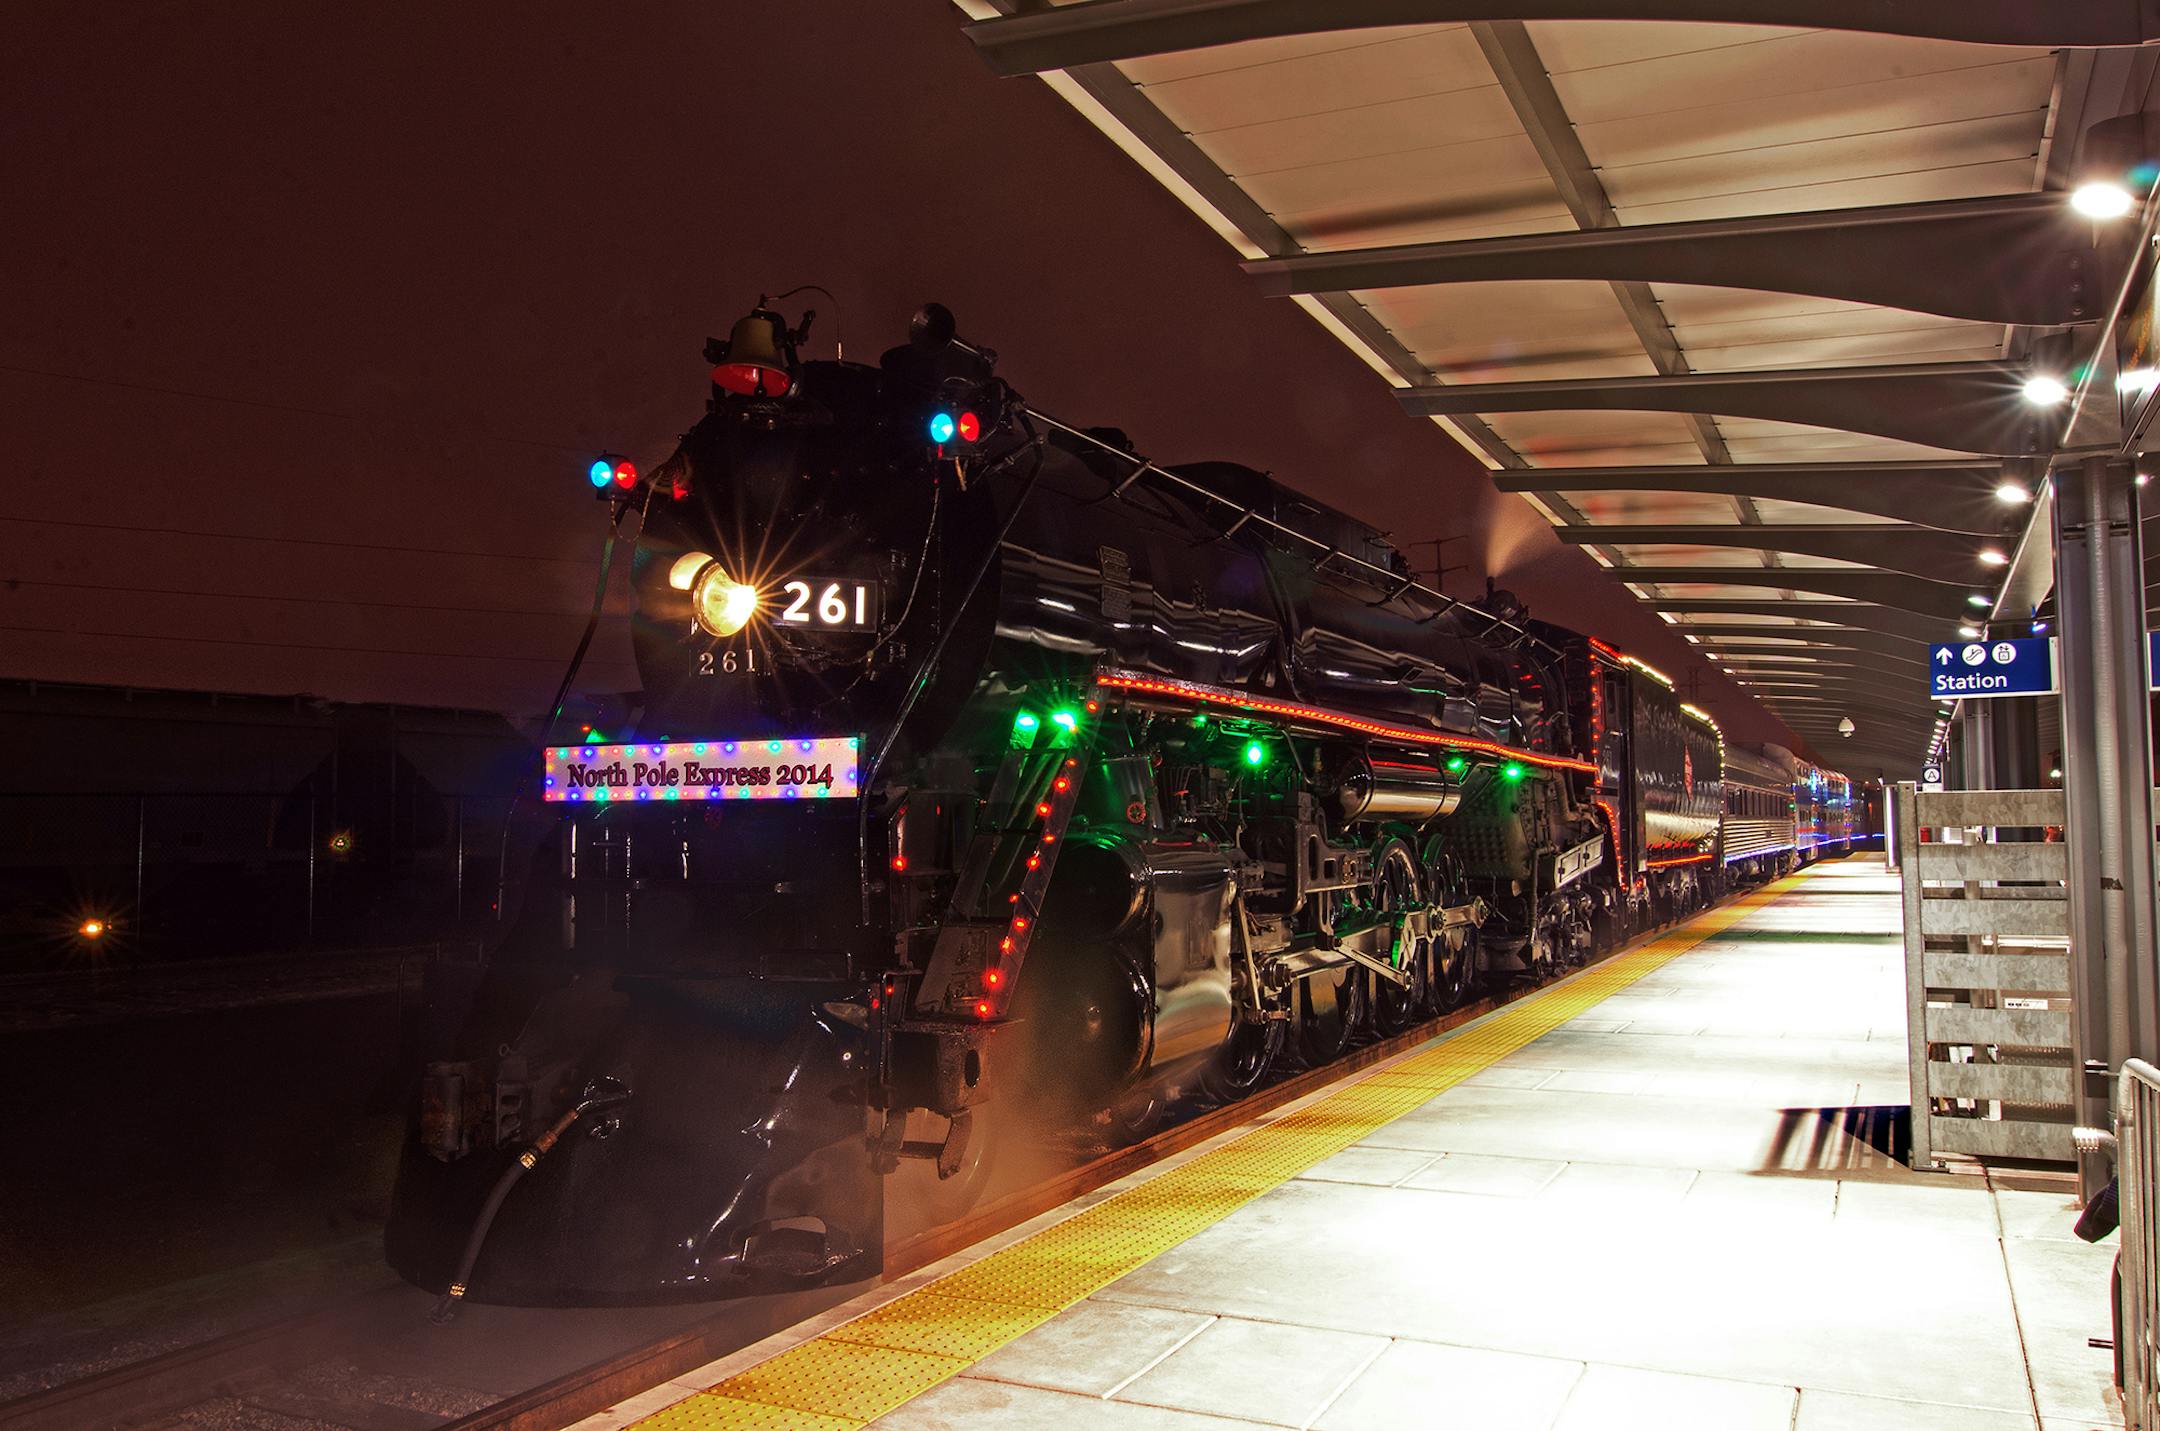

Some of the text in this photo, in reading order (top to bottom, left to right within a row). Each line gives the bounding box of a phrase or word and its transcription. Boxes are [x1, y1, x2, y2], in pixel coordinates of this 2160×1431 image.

[782, 580, 866, 625] 261
[699, 648, 756, 676] 261
[1935, 672, 2008, 691] Station
[566, 760, 834, 790] North Pole Express 2014
